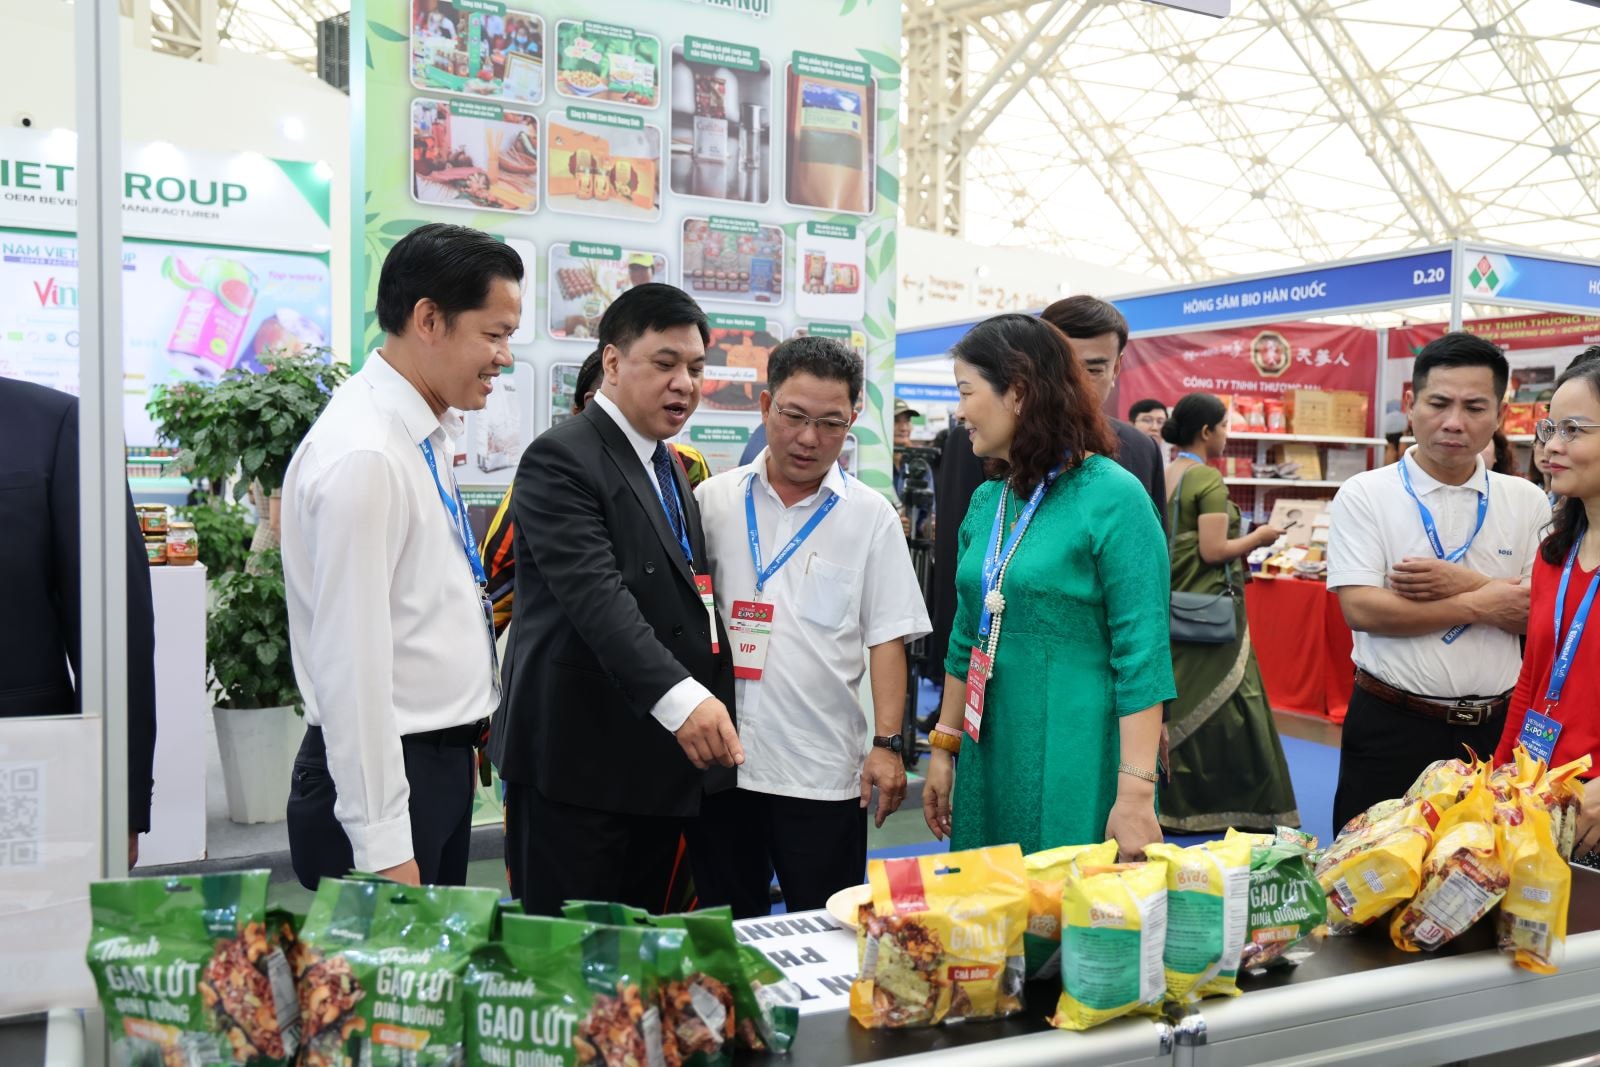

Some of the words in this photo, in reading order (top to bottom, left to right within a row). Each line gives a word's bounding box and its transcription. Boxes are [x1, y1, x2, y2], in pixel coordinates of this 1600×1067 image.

[0, 159, 74, 191] IET
[125, 172, 247, 207] ROUP
[5, 193, 35, 203] OEM
[1413, 267, 1445, 287] D.20
[996, 288, 1005, 309] 2
[1241, 290, 1261, 307] BIO
[1263, 284, 1288, 303] HÀN
[1291, 279, 1327, 300] QUỐC
[1215, 379, 1228, 390] TY
[740, 642, 757, 654] VIP
[1524, 723, 1543, 737] EXPO
[94, 934, 160, 962] Thanh
[767, 946, 828, 968] PH
[153, 958, 201, 999] LỨT
[478, 972, 535, 998] Thanh
[477, 1002, 524, 1046] GẠO
[530, 1005, 578, 1049] LỨT
